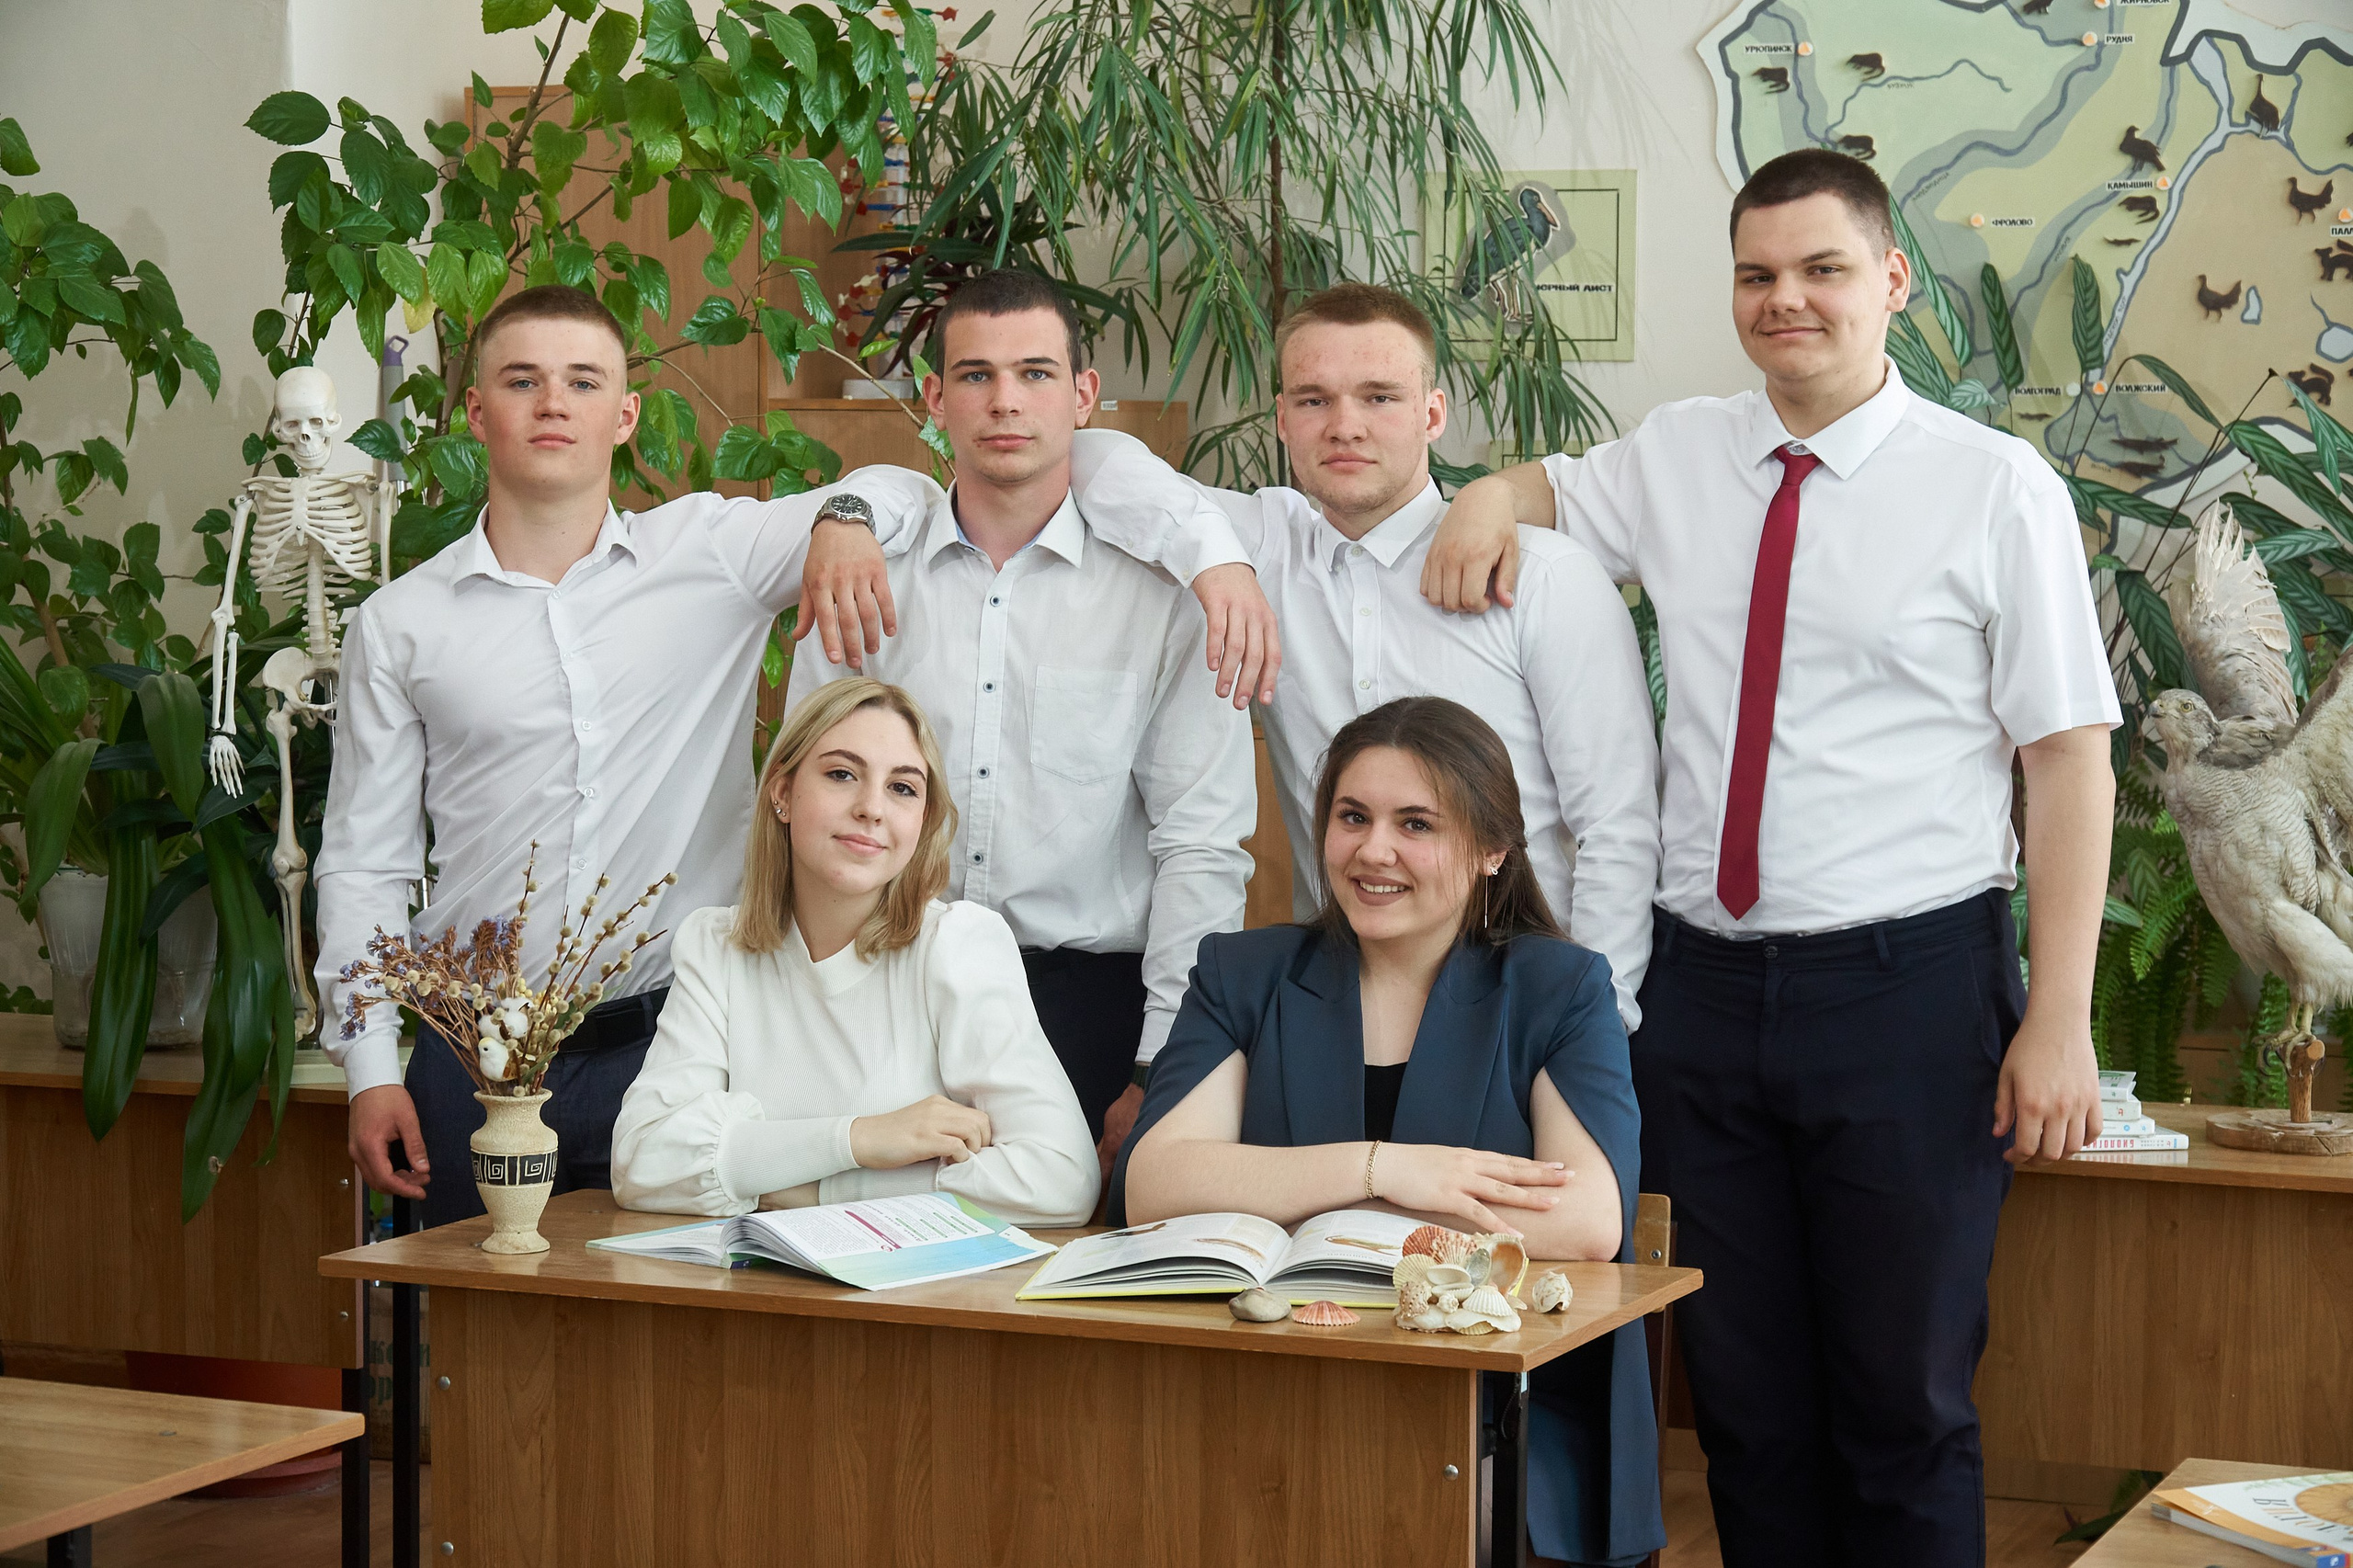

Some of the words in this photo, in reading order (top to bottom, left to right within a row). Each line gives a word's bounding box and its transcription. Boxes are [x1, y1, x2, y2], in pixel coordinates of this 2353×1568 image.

[2106, 35, 2133, 44] РУДНЯ
[1745, 44, 1792, 53] УРЮПИНСК
[2107, 181, 2153, 190] КАМЫШИН
[1992, 219, 2033, 227] ФРОЛОВО
[1583, 284, 1613, 292] АИСТ
[2014, 387, 2061, 396] ВОЛГОГРАД
[2115, 383, 2166, 393] ВОЛЖСКИЙ
